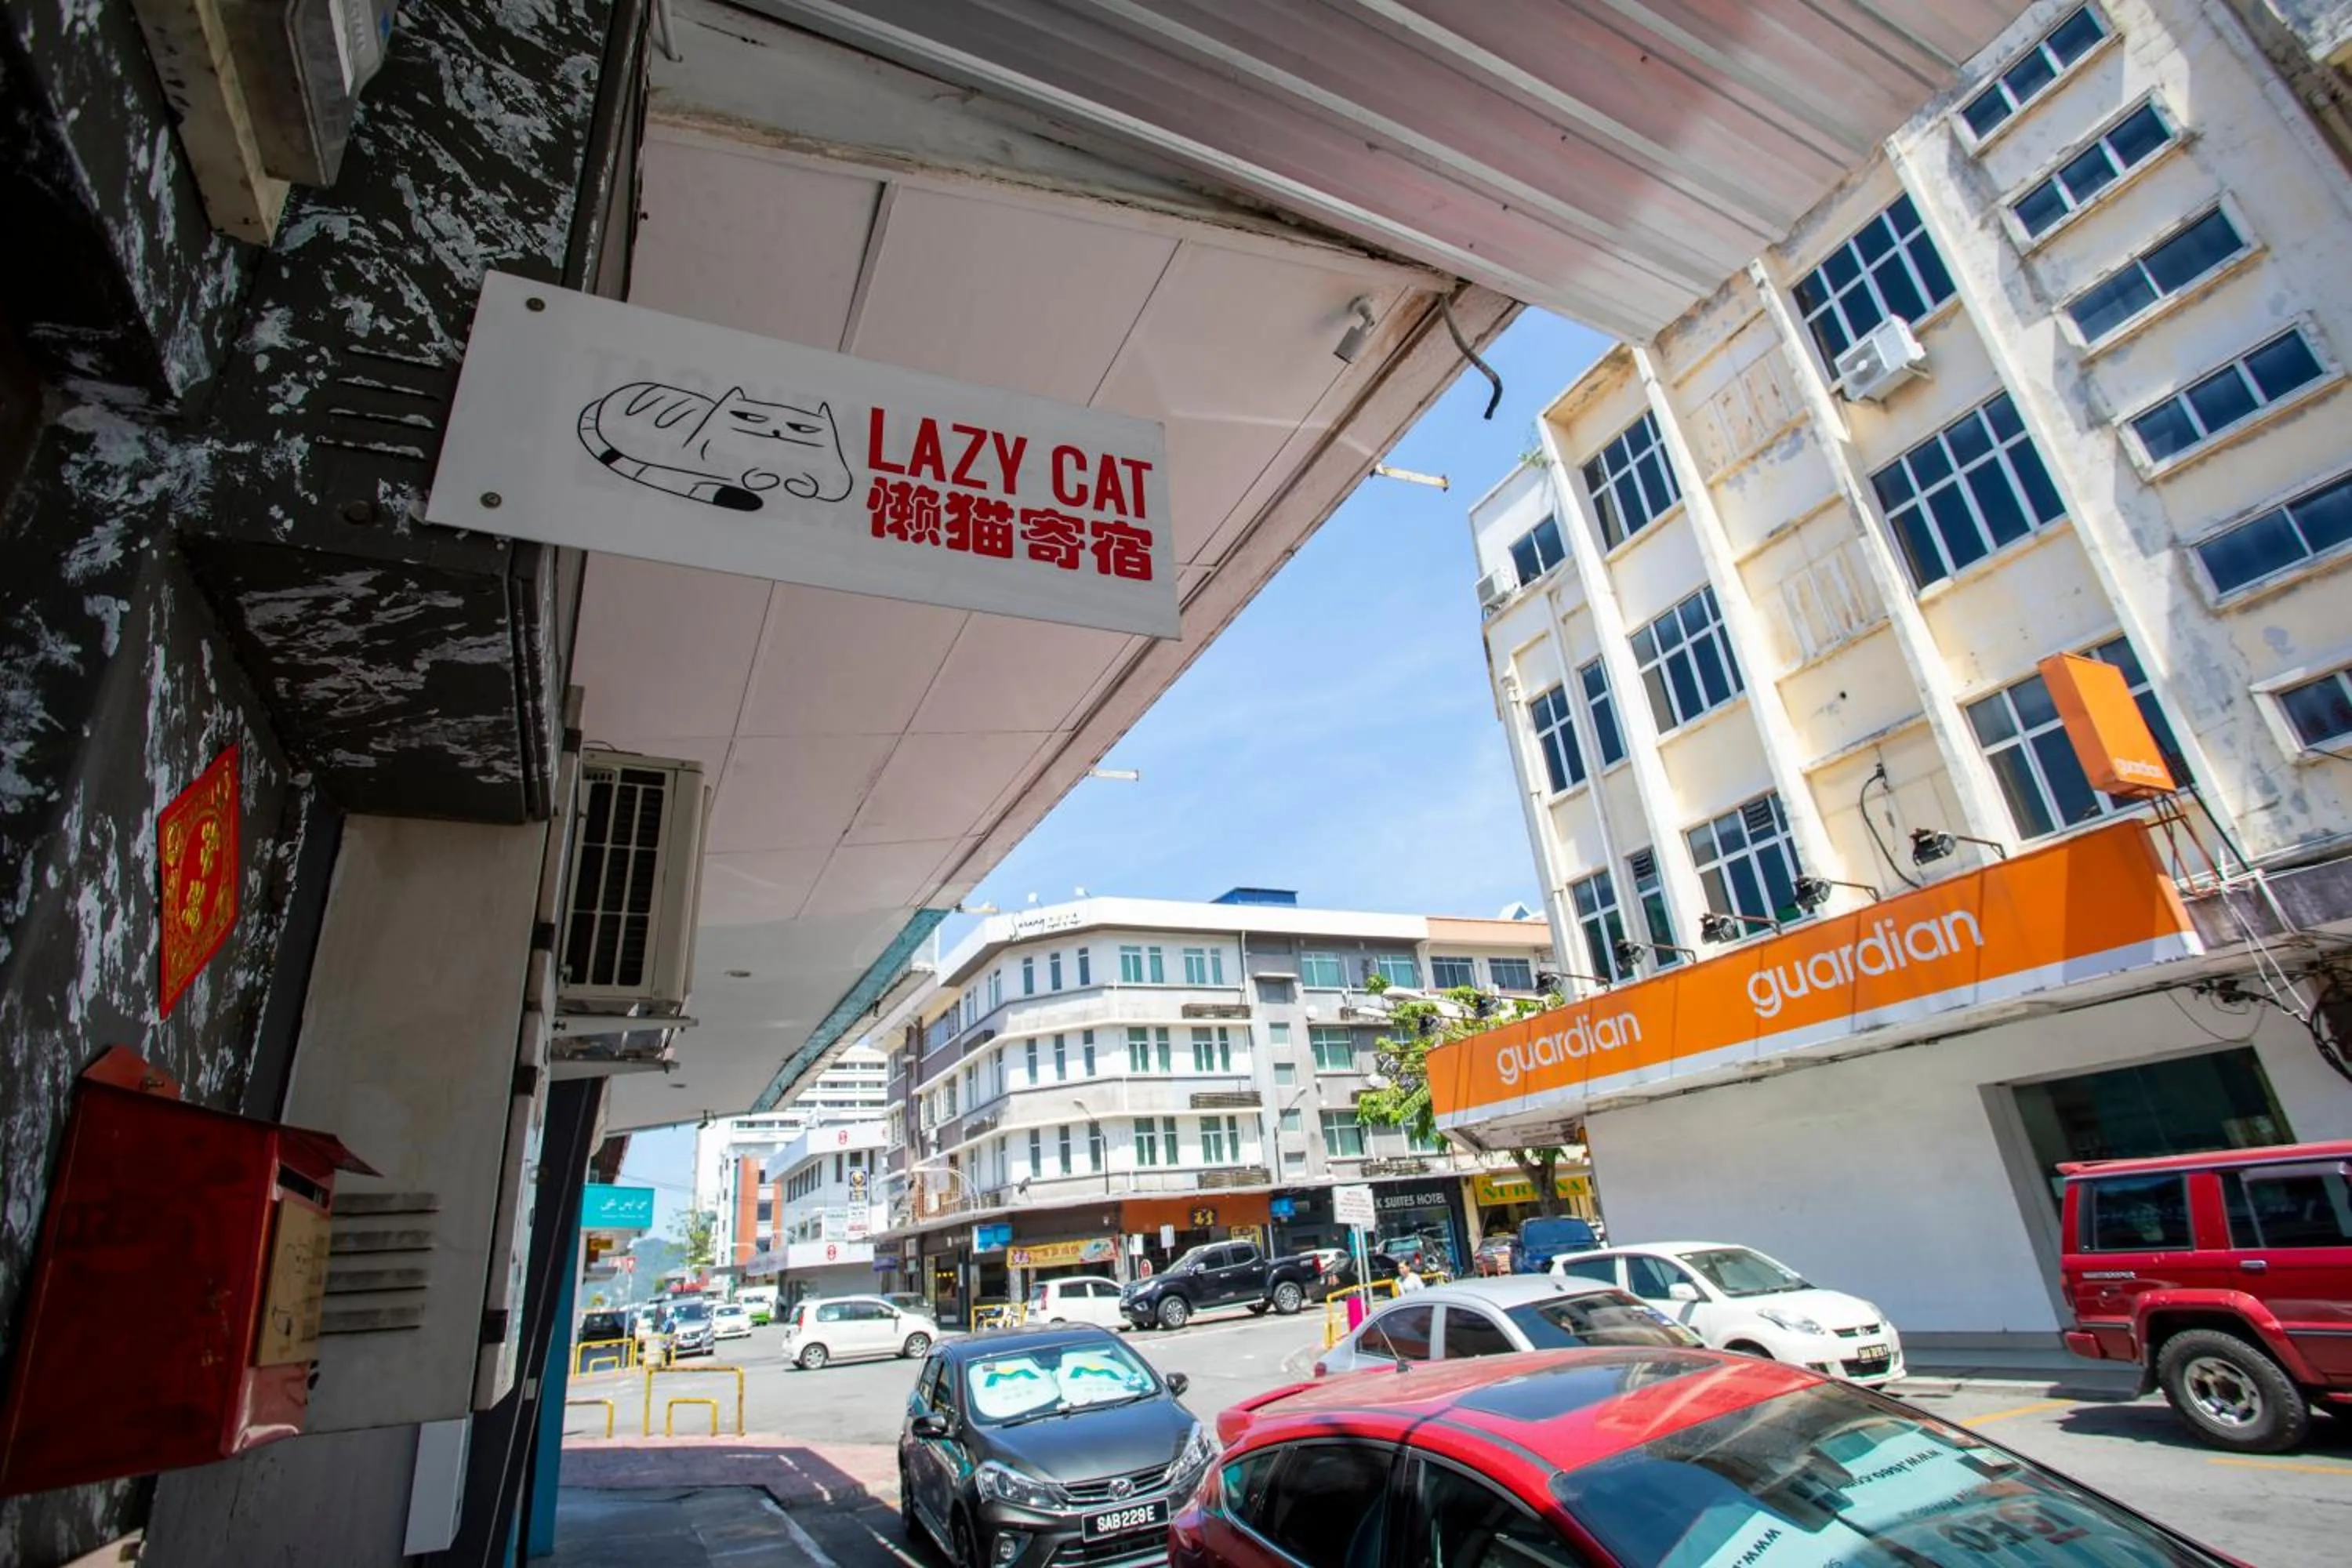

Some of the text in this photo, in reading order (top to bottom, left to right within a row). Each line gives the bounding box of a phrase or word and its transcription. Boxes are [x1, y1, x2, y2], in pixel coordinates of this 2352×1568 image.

[868, 408, 1152, 518] LAZY CAT
[1748, 909, 1984, 1018] guardian
[1496, 1011, 1641, 1085] guardian
[1417, 1192, 1446, 1205] HOTEL
